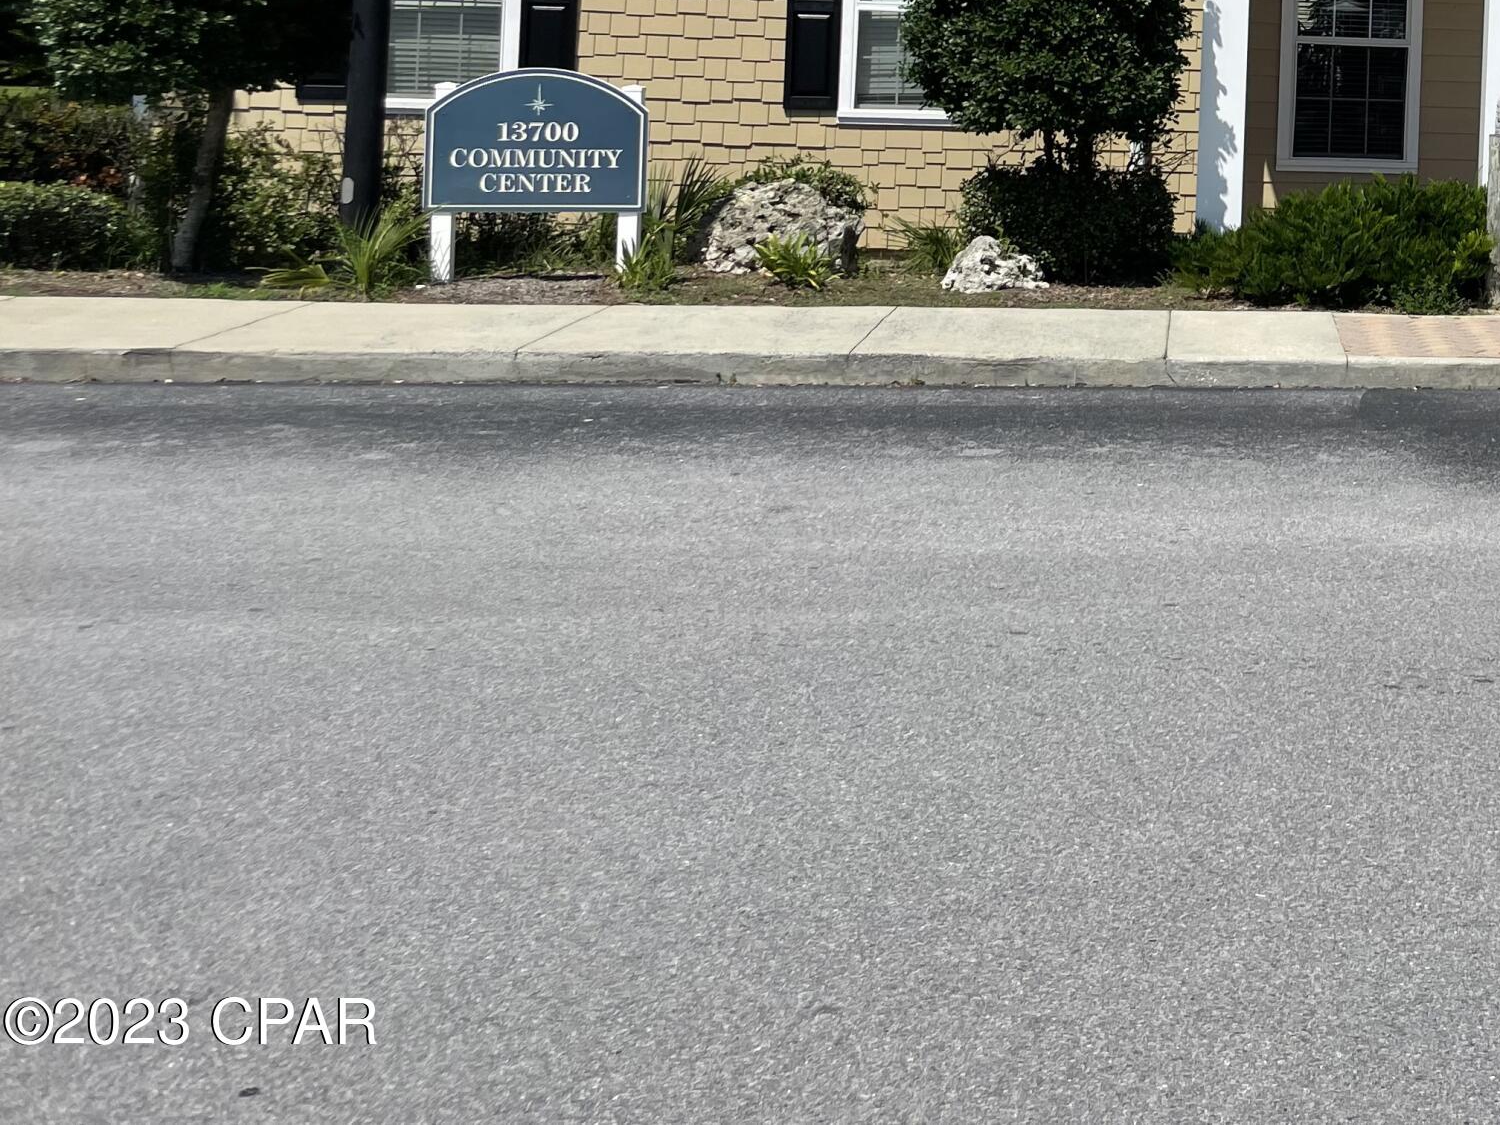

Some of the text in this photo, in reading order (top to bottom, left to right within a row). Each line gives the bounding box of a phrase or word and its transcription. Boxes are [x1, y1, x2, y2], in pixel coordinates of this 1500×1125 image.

[497, 122, 579, 142] 13700
[450, 148, 623, 168] COMMUNITY
[479, 173, 592, 193] CENTER
